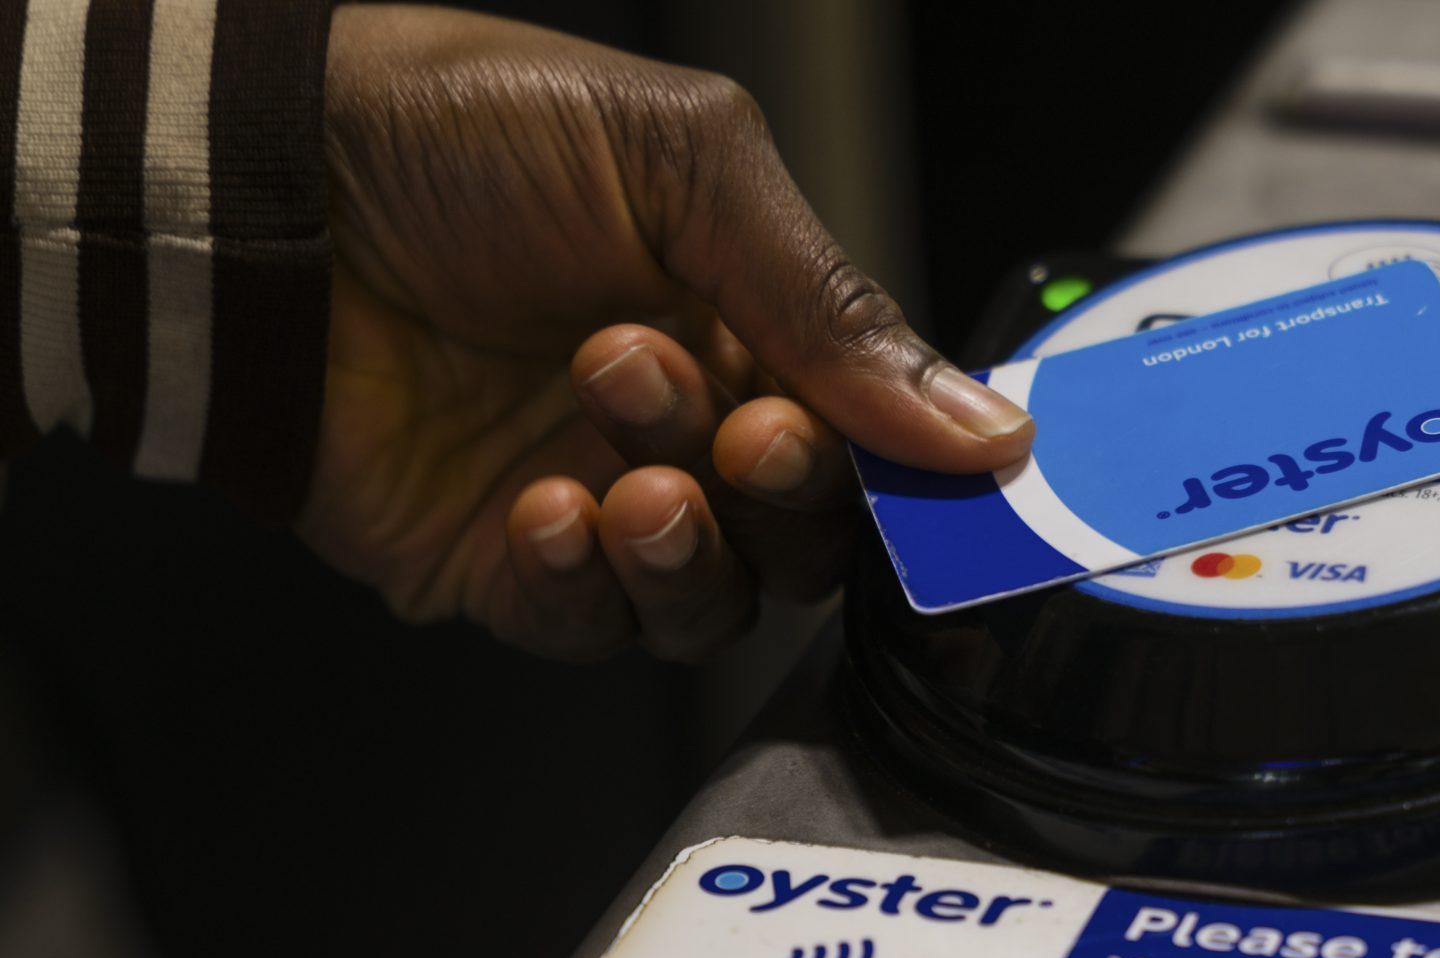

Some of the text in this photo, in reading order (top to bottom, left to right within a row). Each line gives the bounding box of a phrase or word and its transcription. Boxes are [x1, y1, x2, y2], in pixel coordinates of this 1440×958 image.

[1142, 293, 1389, 367] Transport for London
[1286, 561, 1368, 583] VISA
